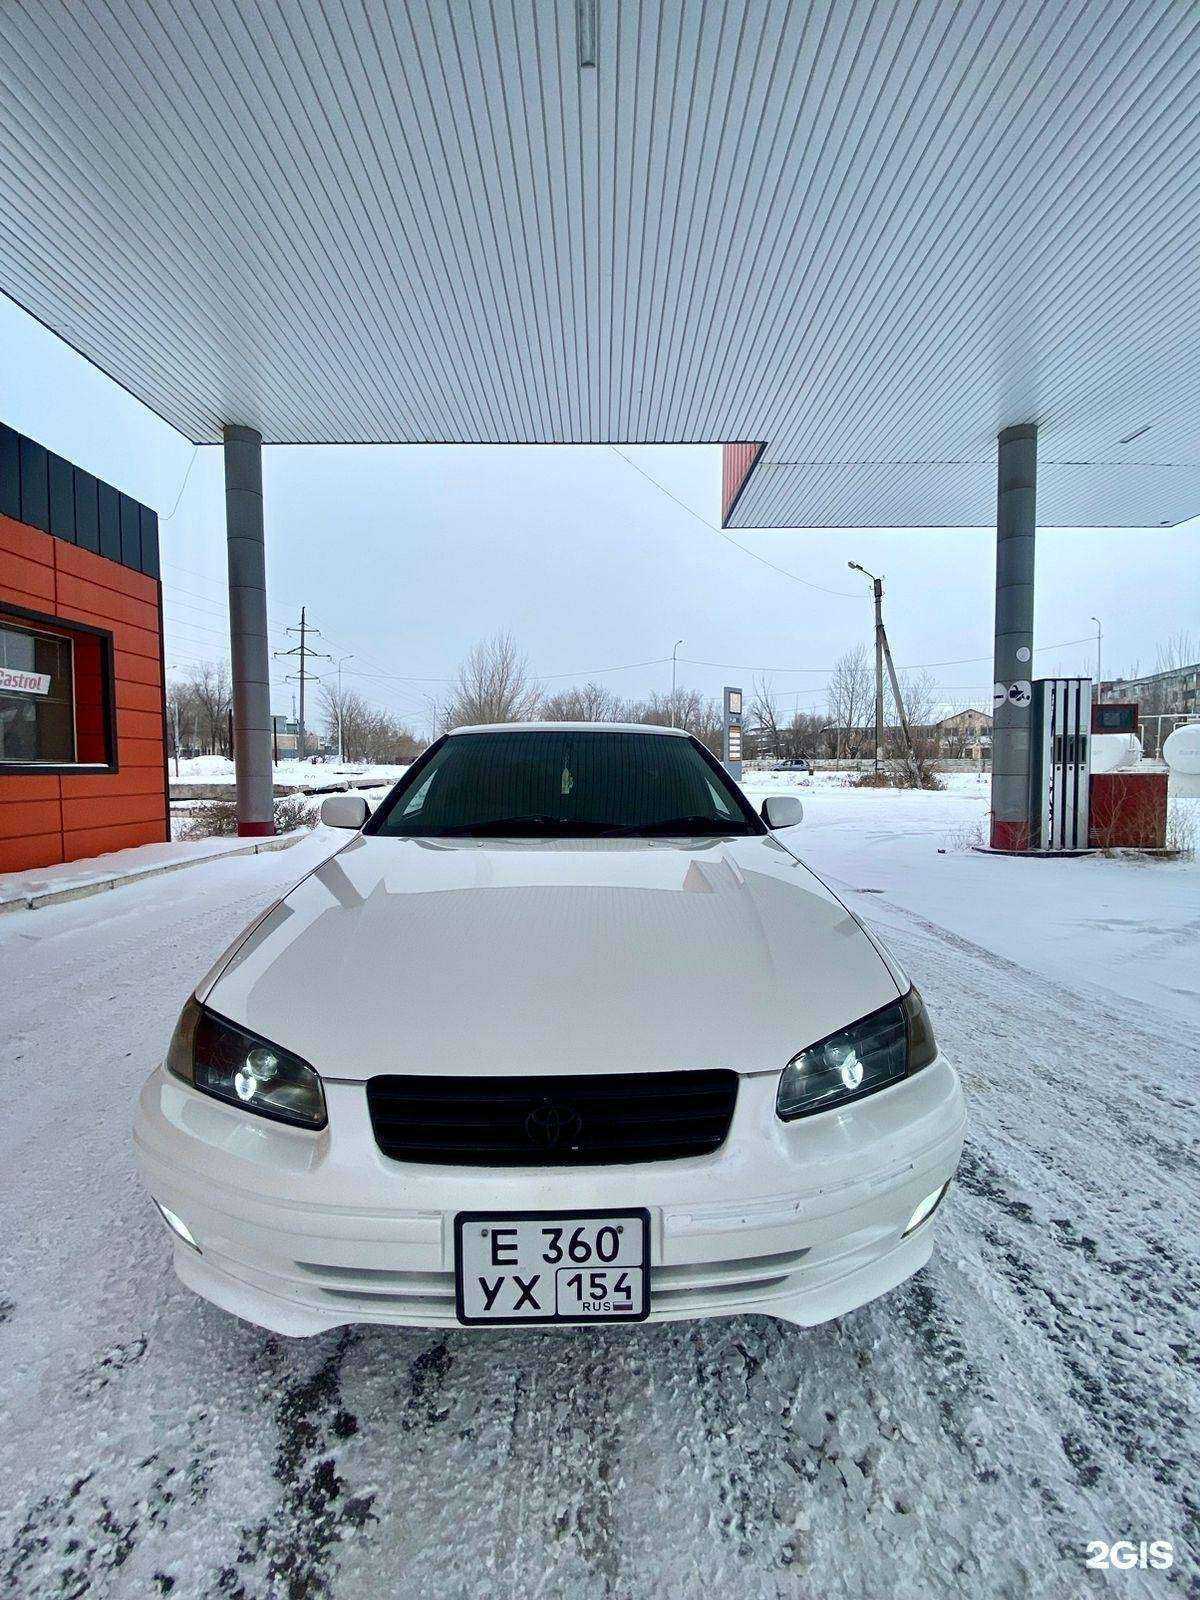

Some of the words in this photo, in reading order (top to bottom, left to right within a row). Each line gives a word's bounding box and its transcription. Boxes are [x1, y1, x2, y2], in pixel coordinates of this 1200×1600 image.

[541, 1225, 621, 1264] 360
[566, 1272, 632, 1301] 154
[582, 1301, 612, 1312] RUS
